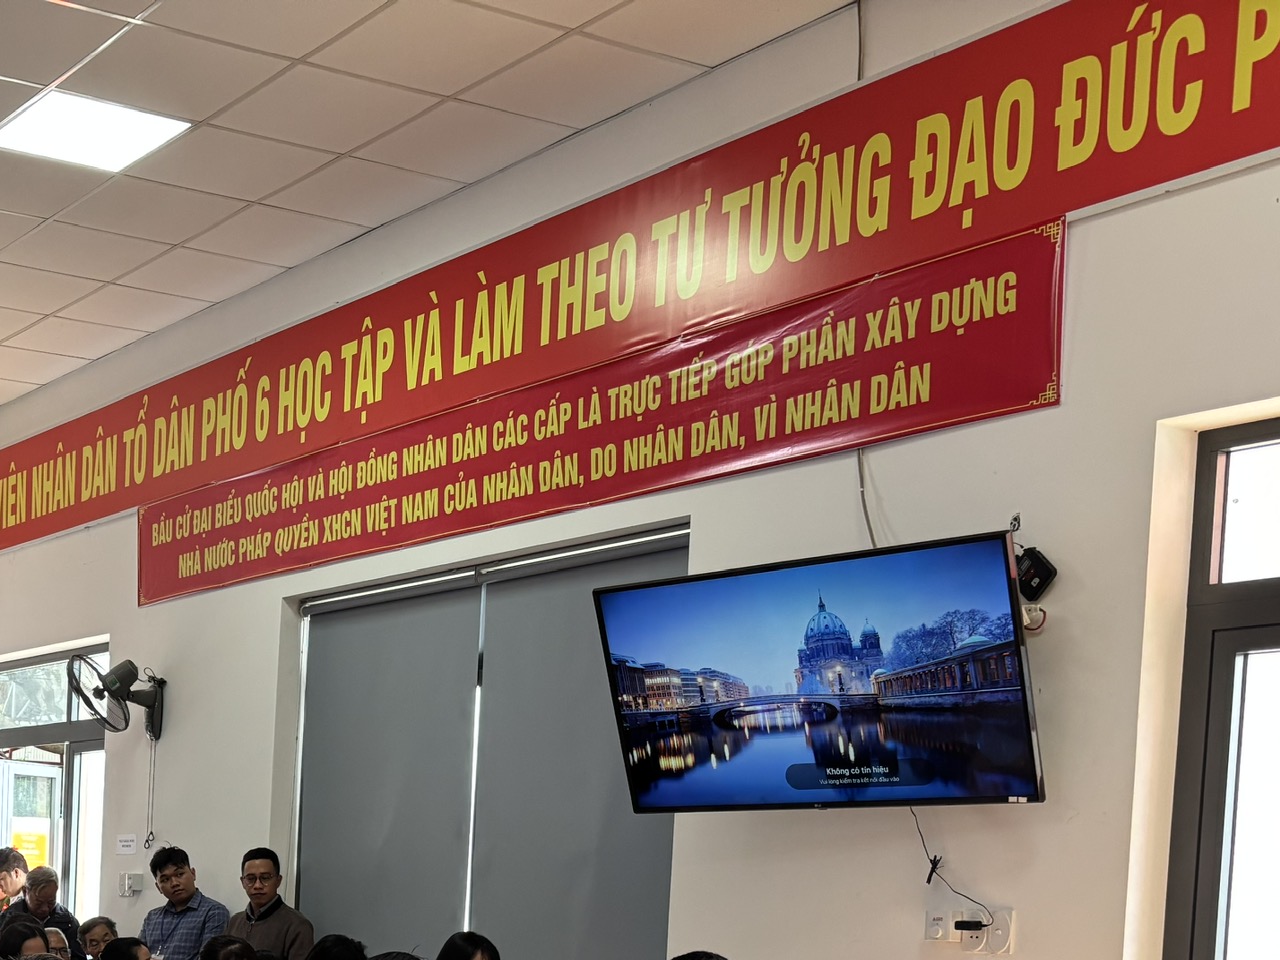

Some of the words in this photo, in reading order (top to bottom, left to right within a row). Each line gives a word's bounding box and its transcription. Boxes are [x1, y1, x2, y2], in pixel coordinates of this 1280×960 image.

[31, 442, 76, 519] NHÂN
[81, 427, 118, 502] DÂN
[123, 395, 148, 488] TỔ
[153, 395, 195, 478] DÂN
[201, 357, 252, 462] PHỐ
[254, 375, 271, 443] 6
[277, 350, 332, 443] HỌC
[341, 316, 394, 424] TẬP
[404, 291, 443, 391] VÀ
[453, 271, 525, 375] LÀM
[537, 232, 636, 347] THEO
[651, 187, 712, 307] TƯ
[721, 131, 892, 284] TƯỞNG
[909, 78, 1034, 229] ĐẠO
[1054, 2, 1206, 172] ĐỨC
[152, 512, 173, 547] BẦU
[176, 505, 192, 540] CỬ
[193, 506, 211, 538] ĐẠI
[215, 489, 242, 529] BIỂU
[245, 479, 278, 522] QUỐC
[281, 475, 303, 514] HỘI
[307, 468, 325, 502] VÀ
[328, 460, 352, 499] HỘI
[357, 448, 398, 489] ĐỒNG
[402, 434, 447, 477] NHÂN
[452, 422, 487, 464] DÂN
[492, 411, 528, 452] CÁC
[534, 392, 572, 441] CẤP
[578, 386, 602, 430] LÀ
[608, 374, 662, 422] TRỰC
[667, 351, 718, 405] TIẾP
[724, 339, 775, 389] GÓP
[782, 310, 856, 375] PHẦN
[864, 296, 922, 352] XÂY
[930, 271, 1017, 336] DỰNG
[178, 545, 202, 579] NHÀ
[204, 537, 236, 572] NƯỚC
[238, 529, 271, 563] PHÁP
[274, 513, 319, 556] QUYỀN
[322, 509, 362, 544] XHCN
[366, 495, 397, 536] VIỆT
[402, 487, 439, 525] NAM
[444, 471, 478, 515] CỦA
[482, 462, 533, 505] NHÂN
[539, 450, 584, 488] DÂN,
[590, 443, 617, 481] DO
[623, 424, 684, 473] NHÂN
[691, 410, 745, 458] DÂN,
[754, 394, 777, 442] VÌ
[785, 378, 861, 435] NHÂN
[870, 361, 931, 415] DÂN
